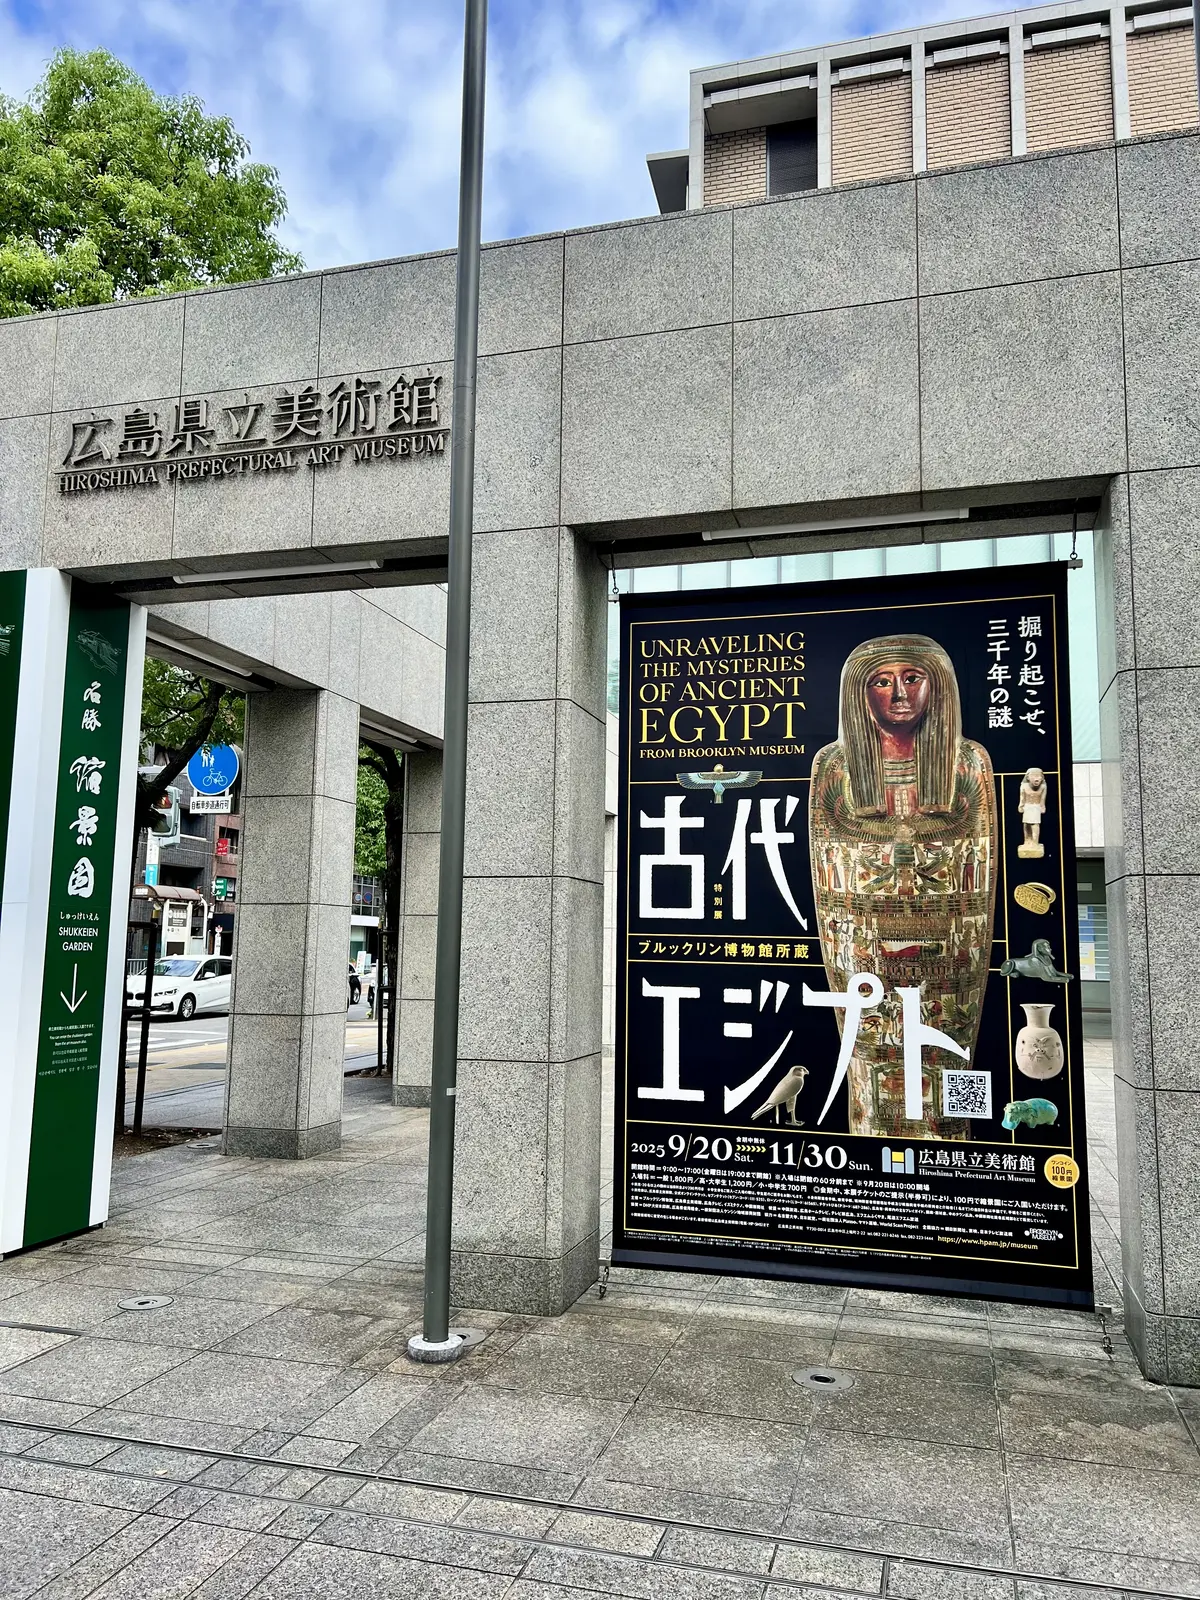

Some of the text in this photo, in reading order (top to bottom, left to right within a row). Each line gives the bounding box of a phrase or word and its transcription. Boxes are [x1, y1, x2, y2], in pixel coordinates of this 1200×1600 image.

[62, 368, 442, 466] 広島県立美術館
[58, 434, 444, 493] HIROSHIMA PREFECTURAL ART MUSEUM
[640, 632, 805, 658] UNRAVELING
[640, 655, 805, 678] THE MYSTERIES
[987, 619, 1014, 728] 三千年の謎
[1018, 616, 1046, 734] 掘り起こせ、
[639, 676, 805, 703] OF ANCIENT
[639, 702, 806, 743] EGYPT
[640, 745, 805, 758] FROM BROOKLYN MUSEUM
[639, 795, 808, 931] 古代
[713, 883, 722, 920] 特別展
[60, 911, 99, 920] しゅっけいえん
[58, 927, 98, 936] SHUKKEIEN
[62, 942, 93, 951] GARDEN
[638, 940, 809, 959] ブルックリン博物館所蔵
[637, 972, 971, 1125] エジプト
[631, 1133, 754, 1163] 2025 9/20 Sat.
[769, 1140, 873, 1171] 11/30 Sun.
[919, 1149, 1035, 1171] 広島県立美術館
[919, 1168, 953, 1177] Hiroshima
[955, 1170, 992, 1180] Prefectural
[1007, 1174, 1035, 1182] Museum
[1052, 1166, 1072, 1175] 100円
[937, 1235, 1039, 1250] https://www.hpam.jp/museum
